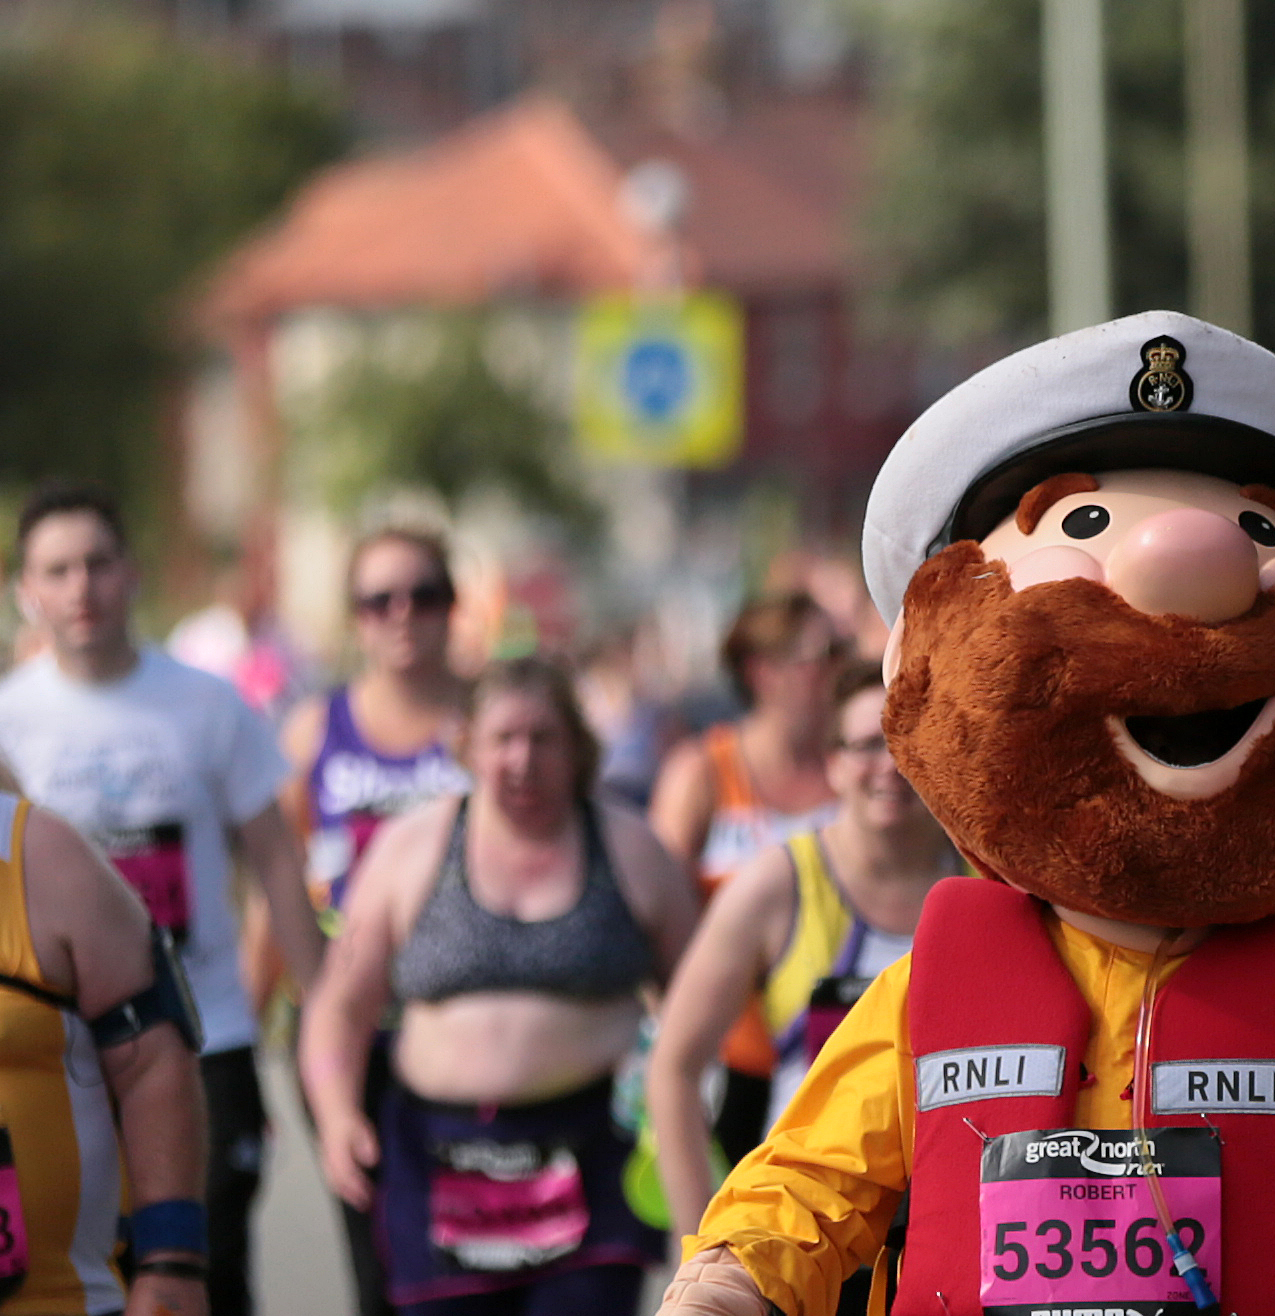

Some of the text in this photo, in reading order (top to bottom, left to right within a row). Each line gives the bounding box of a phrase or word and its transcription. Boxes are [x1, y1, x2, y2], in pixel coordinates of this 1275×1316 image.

[942, 1054, 1026, 1094] RNLI
[1025, 1137, 1156, 1163] great north
[1059, 1184, 1137, 1200] ROBERT
[993, 1217, 1208, 1281] 53562
